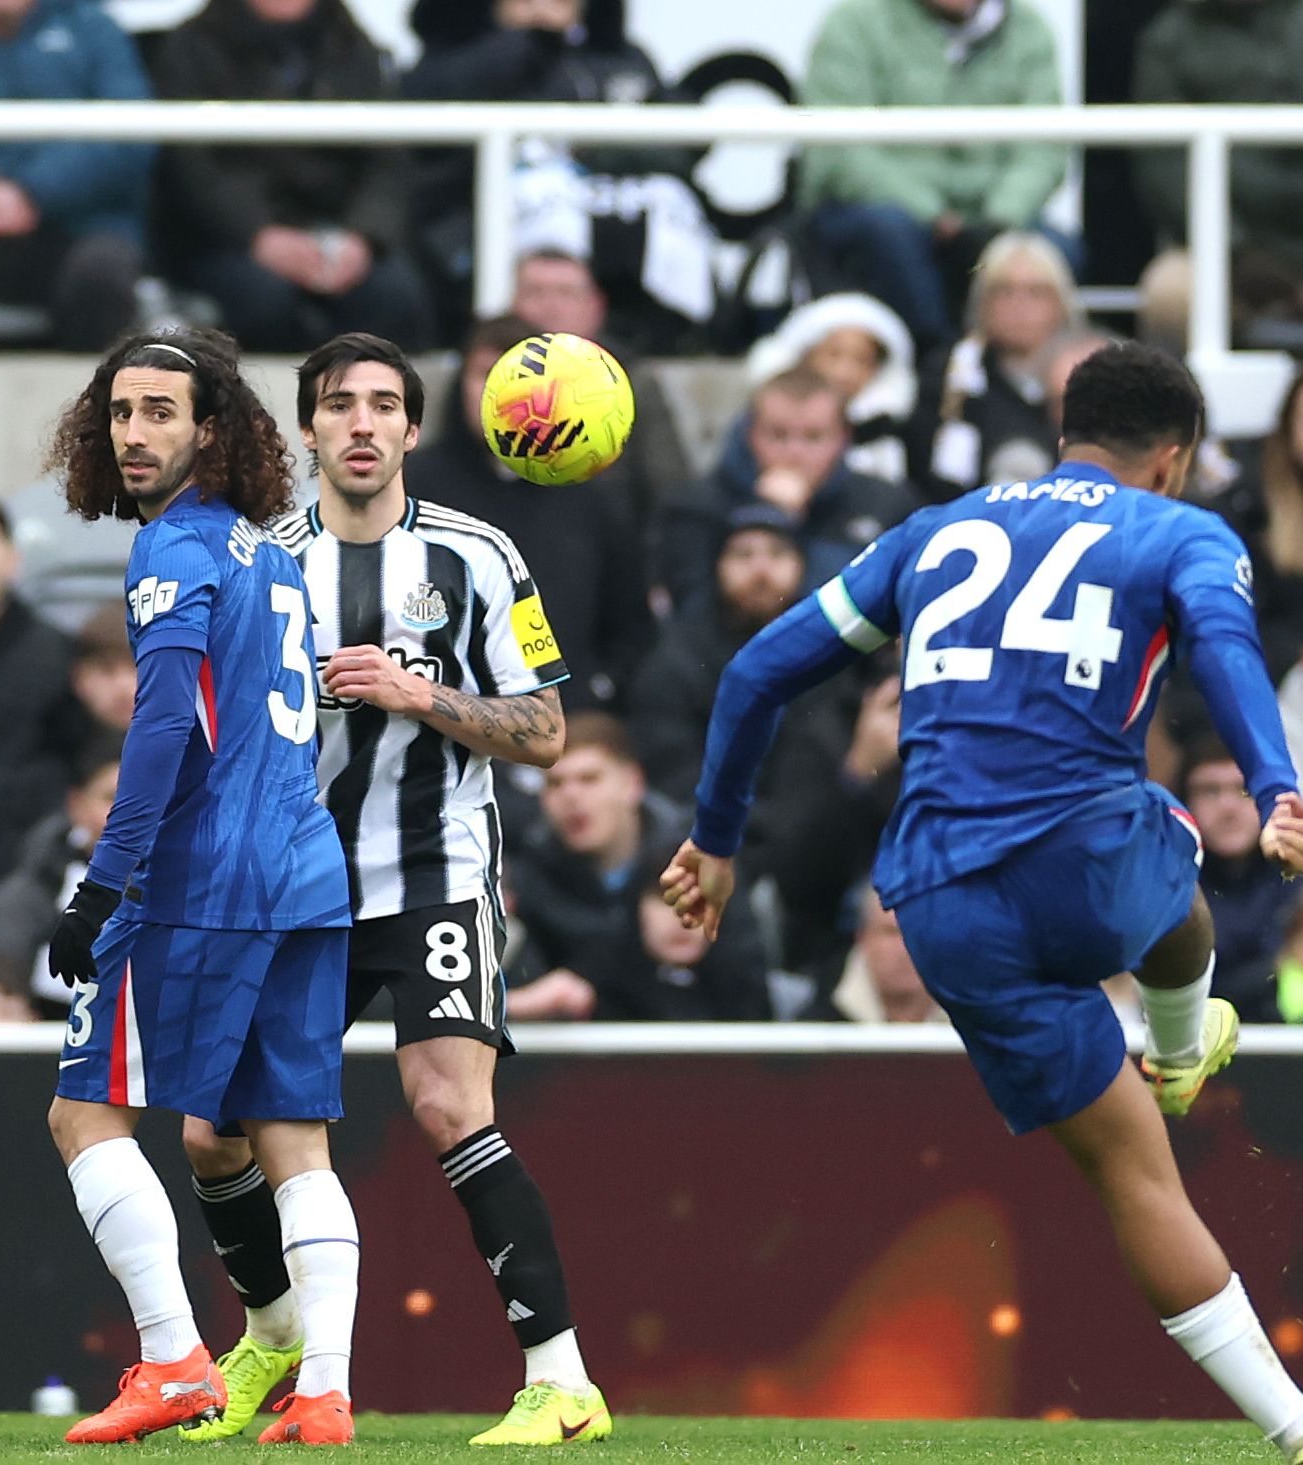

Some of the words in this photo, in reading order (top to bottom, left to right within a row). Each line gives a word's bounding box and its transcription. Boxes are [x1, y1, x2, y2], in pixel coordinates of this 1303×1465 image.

[903, 518, 1124, 692] 24
[267, 582, 317, 745] 3
[425, 921, 472, 982] 8
[66, 982, 100, 1048] 3
